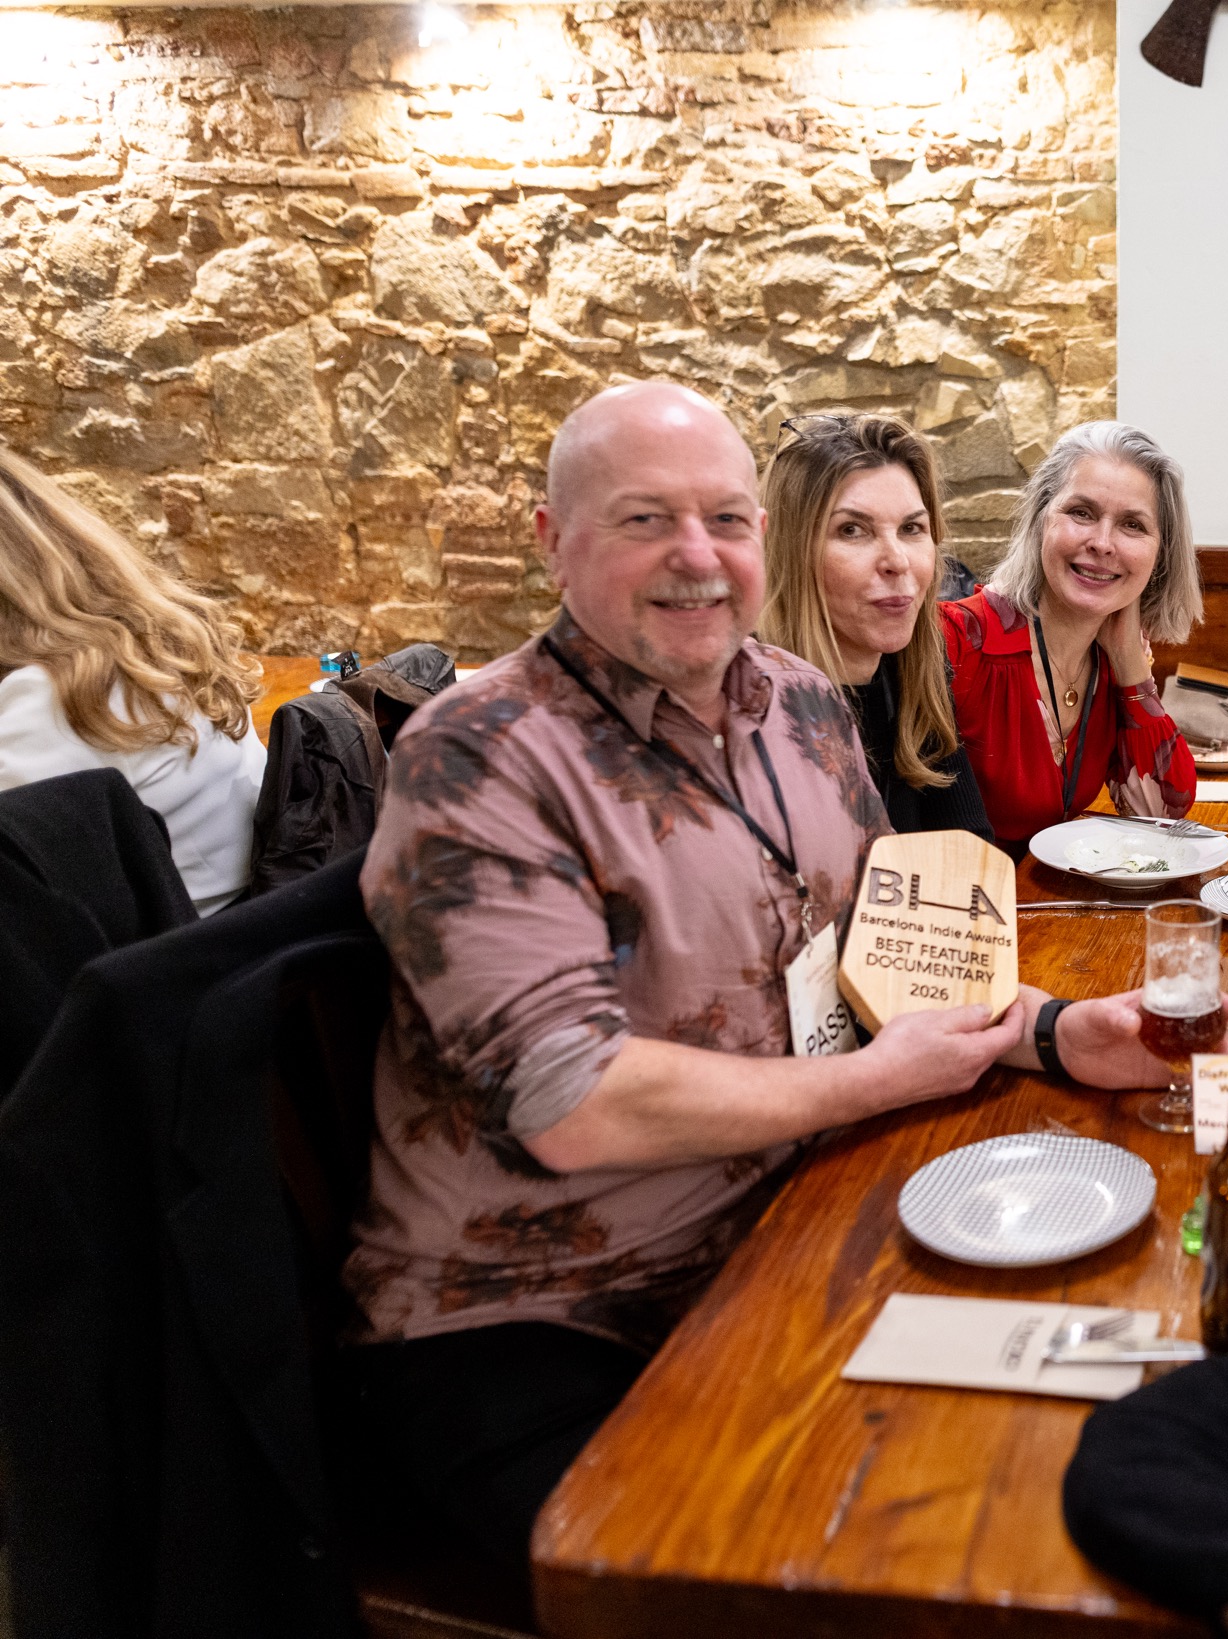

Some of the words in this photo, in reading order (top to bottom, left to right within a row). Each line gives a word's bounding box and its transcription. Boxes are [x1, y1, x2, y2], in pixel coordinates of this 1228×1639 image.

[860, 912, 925, 933] Barcelona
[930, 923, 963, 940] Indie
[965, 930, 1013, 948] Awards
[875, 936, 915, 954] BEST
[920, 944, 990, 967] FEATURE
[866, 952, 996, 985] DOCUMENTARY
[910, 982, 950, 1001] 2026
[806, 1003, 849, 1057] PASS
